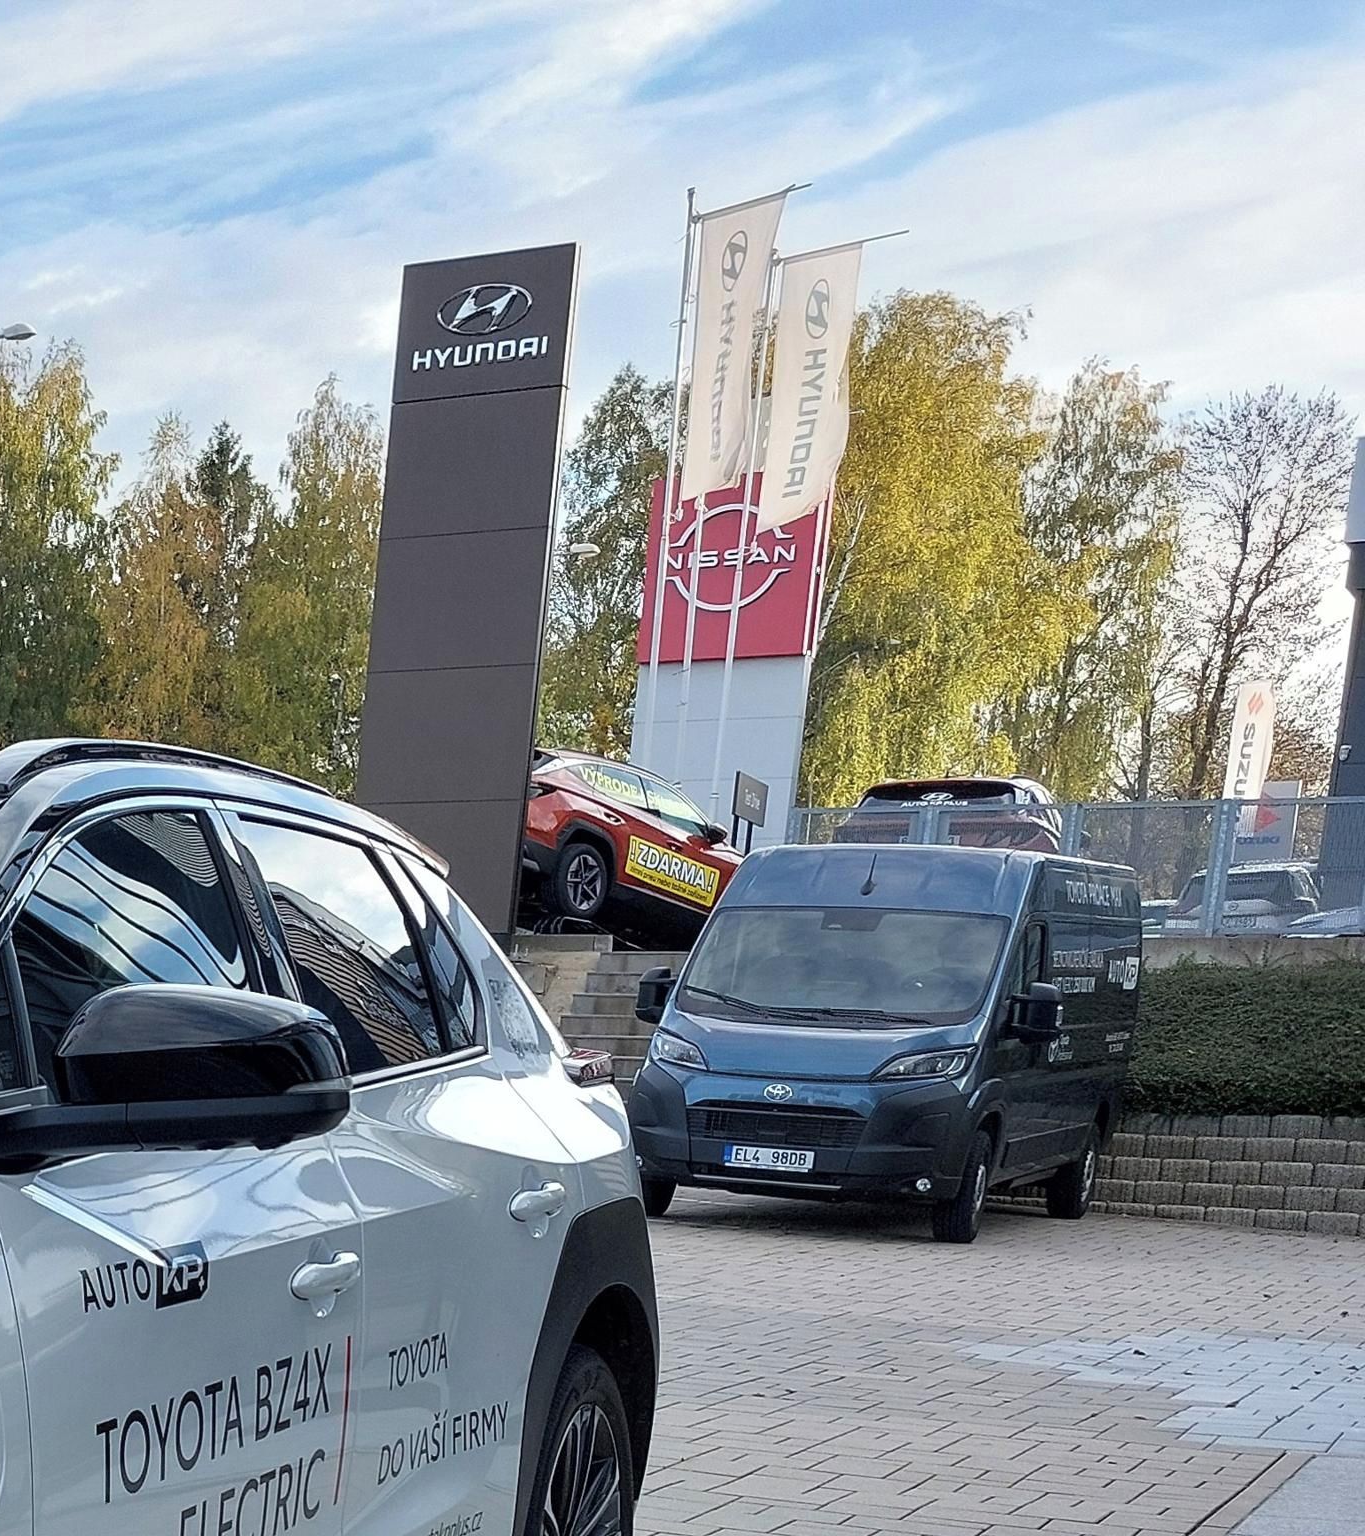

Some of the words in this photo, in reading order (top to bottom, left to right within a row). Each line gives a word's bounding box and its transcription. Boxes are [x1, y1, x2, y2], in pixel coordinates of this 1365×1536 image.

[412, 337, 549, 371] HYUNDAI
[782, 349, 828, 498] HYUNDAI
[1232, 723, 1256, 800] SUZU
[734, 1147, 760, 1162] EL4
[771, 1150, 808, 1166] 98DB
[79, 1259, 151, 1313] AUTO
[388, 1332, 448, 1391] TOYOTA
[95, 1375, 245, 1504] TOYOTA
[254, 1342, 333, 1443] BZ4X
[377, 1438, 404, 1485] DO
[409, 1408, 448, 1470] VAŠÍ
[452, 1401, 509, 1455] FIRMY
